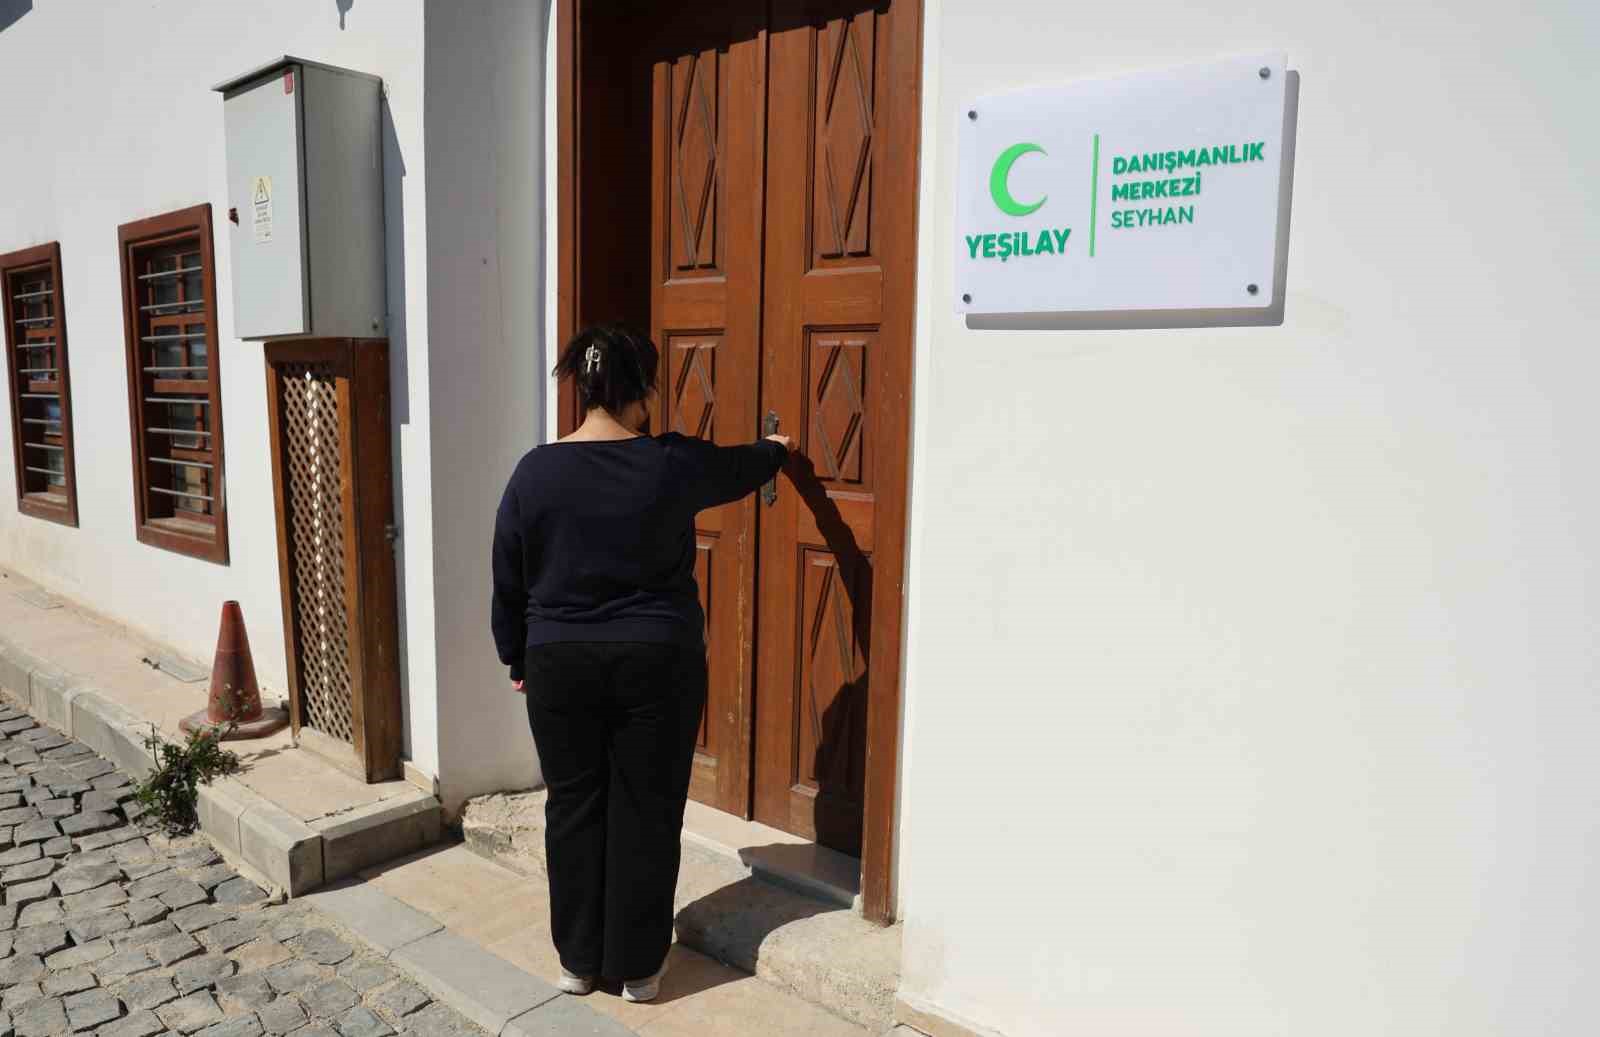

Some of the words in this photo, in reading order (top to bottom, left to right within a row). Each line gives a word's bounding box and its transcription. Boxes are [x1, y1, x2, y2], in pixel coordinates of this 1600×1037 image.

[1112, 142, 1265, 175] DANIŞMANLIK
[1111, 172, 1201, 201] MERKEZİ
[1111, 206, 1194, 228] SEYHAN
